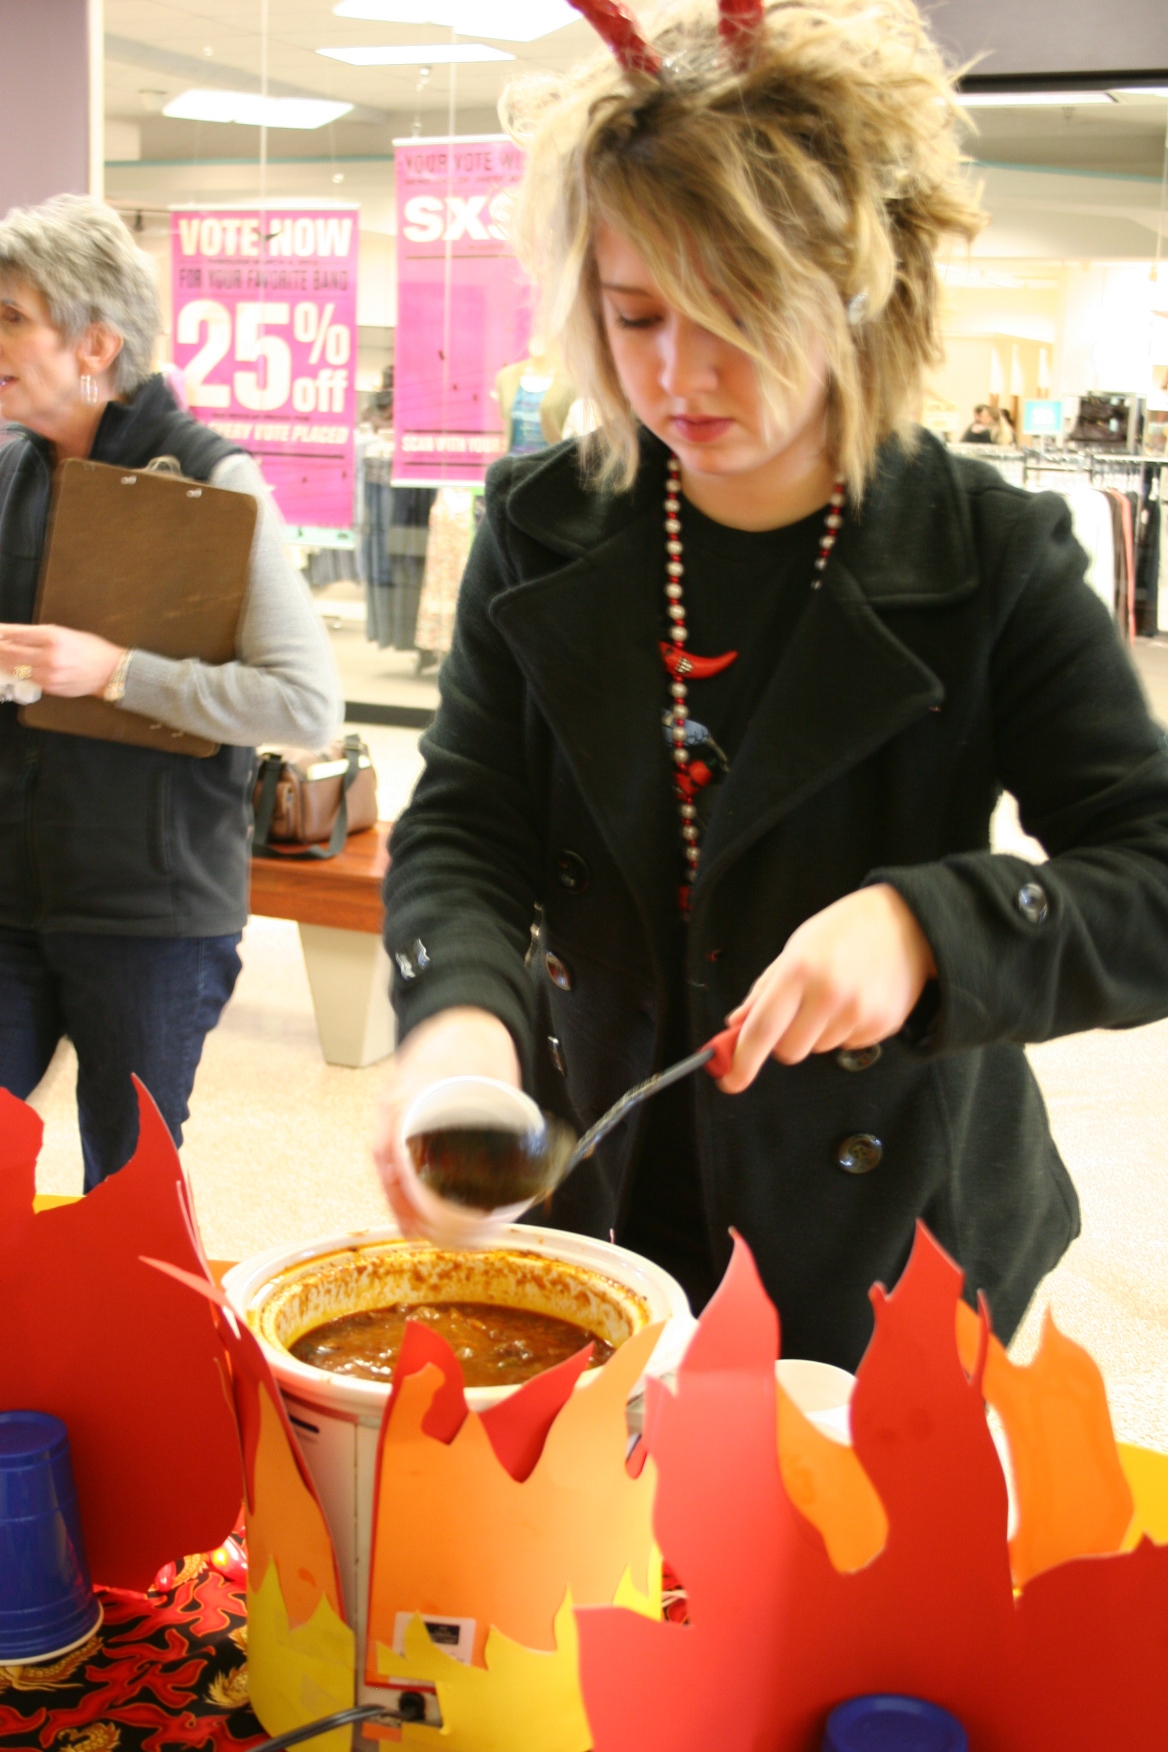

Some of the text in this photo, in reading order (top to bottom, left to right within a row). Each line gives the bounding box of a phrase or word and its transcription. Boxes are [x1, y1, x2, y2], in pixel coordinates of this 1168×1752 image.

[405, 153, 447, 174] YOUR
[454, 152, 492, 172] VOTE
[179, 219, 352, 256] VOTE NOW
[179, 269, 349, 290] FOR YOUR FAVORITE BAND
[293, 369, 347, 412] off
[254, 424, 289, 441] VOTE
[291, 425, 349, 444] PLACED
[402, 435, 433, 452] SCAN
[435, 436, 466, 452] WITH
